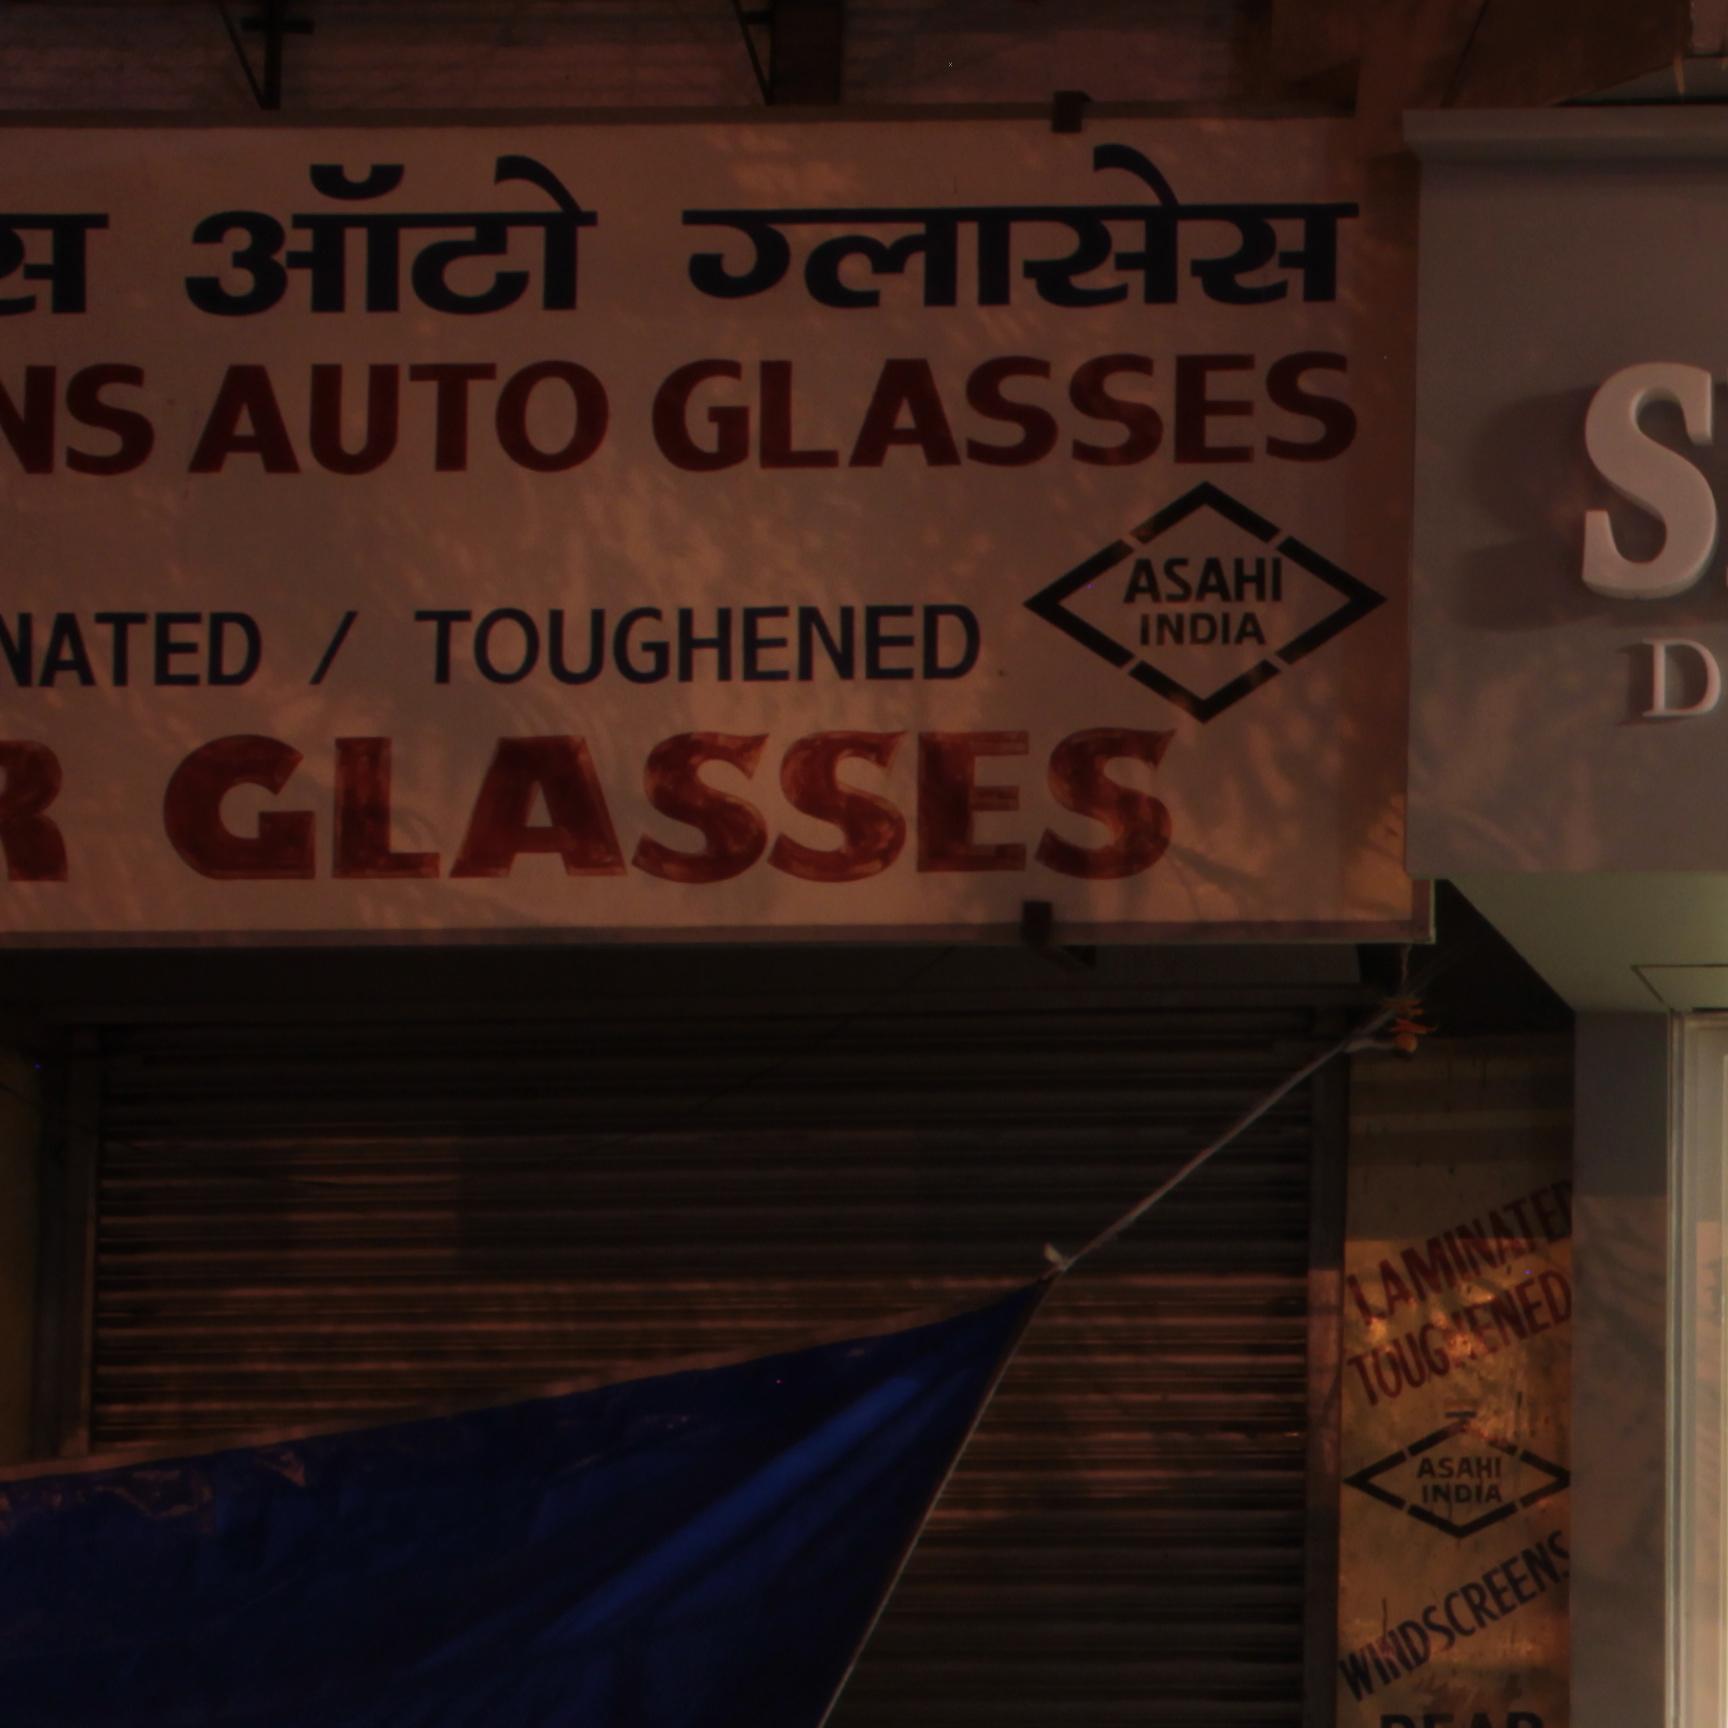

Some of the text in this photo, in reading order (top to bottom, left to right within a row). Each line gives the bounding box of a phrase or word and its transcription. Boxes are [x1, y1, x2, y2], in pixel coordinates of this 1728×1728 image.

[184, 153, 599, 318] ऑटो
[682, 143, 1360, 308] ग्लासेस
[188, 360, 612, 476] AUTO
[651, 350, 1360, 473] GLASSES
[1122, 556, 1284, 604] ASAHI
[414, 602, 982, 687] TOUGHENED
[1139, 611, 1267, 647] INDIA
[163, 726, 1177, 884] GLASSES
[1416, 1455, 1503, 1481] ASAHI
[1420, 1482, 1503, 1506] INDIA
